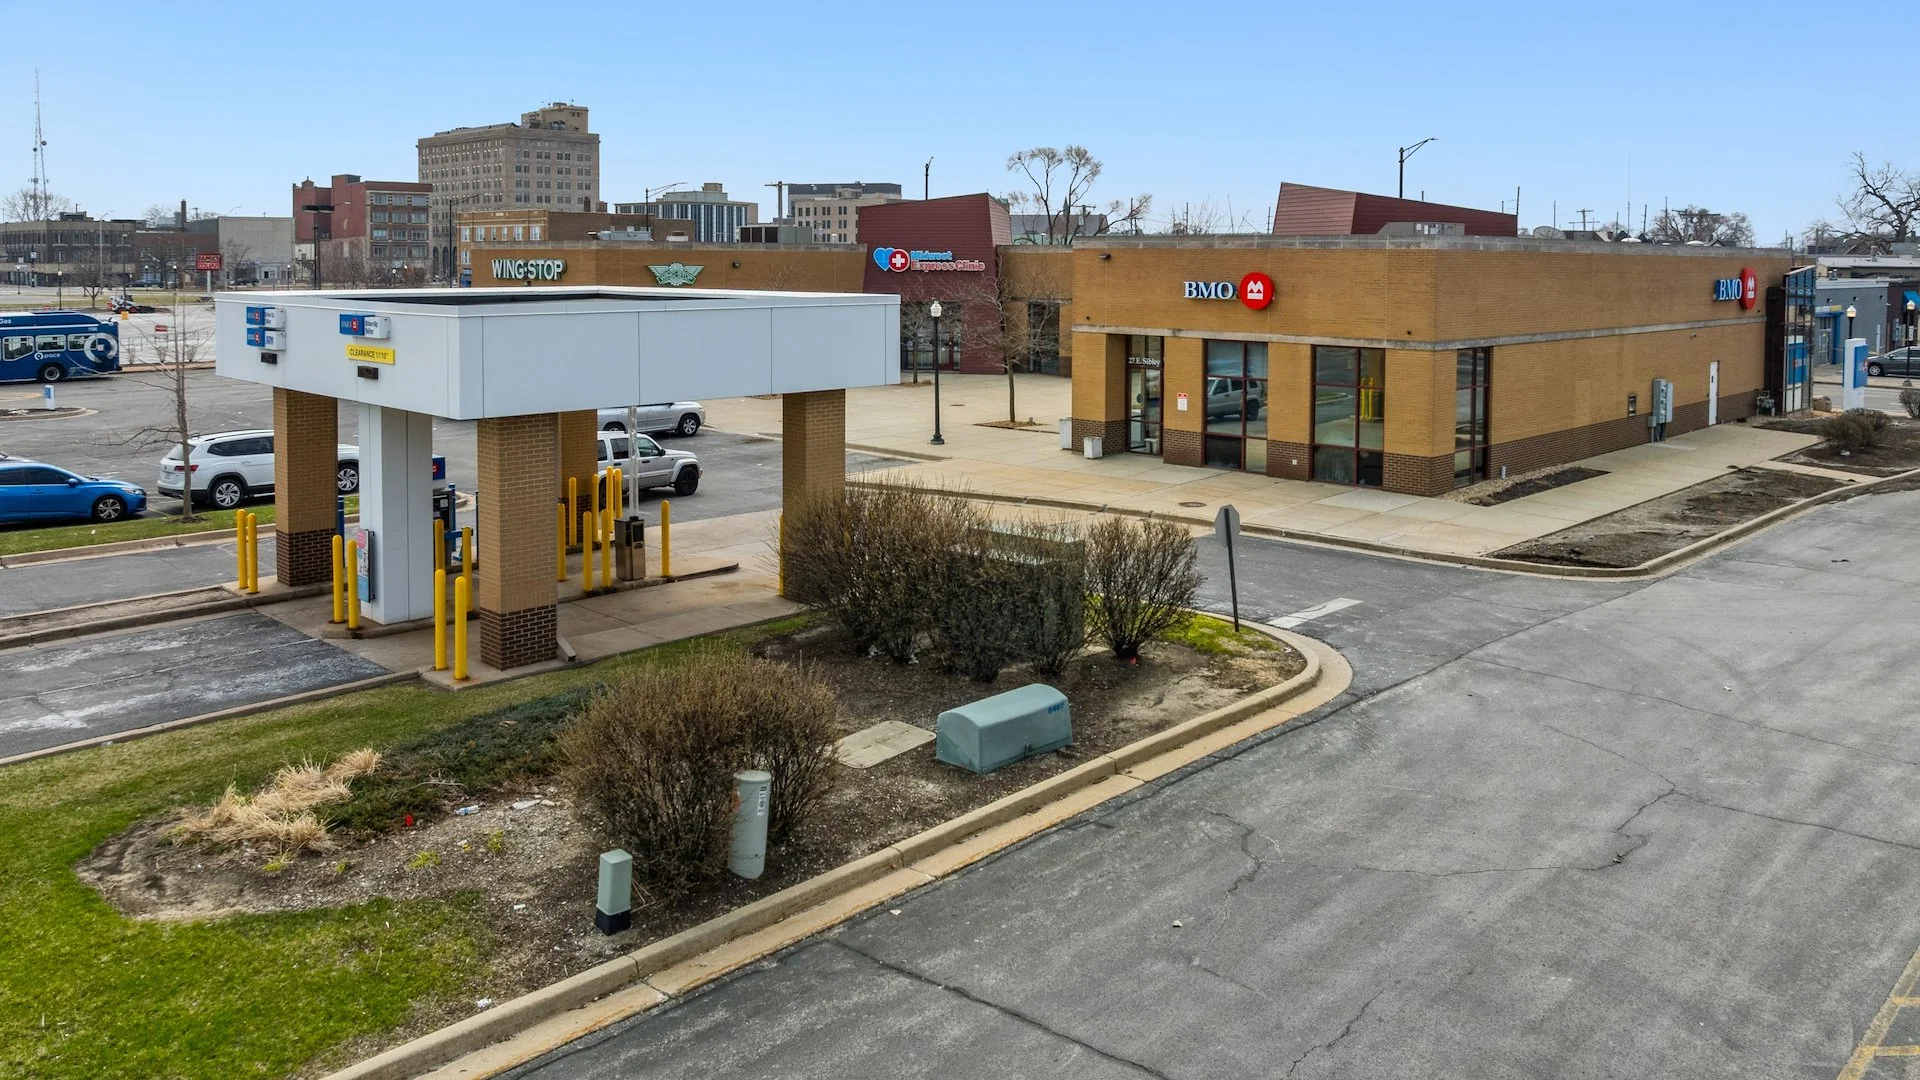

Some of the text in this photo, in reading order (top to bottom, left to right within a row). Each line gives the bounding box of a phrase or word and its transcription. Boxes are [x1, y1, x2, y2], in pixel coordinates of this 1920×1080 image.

[911, 250, 953, 260] Midwest
[911, 260, 985, 271] Express Clinic
[1183, 281, 1235, 300] BMO
[1719, 278, 1743, 301] BMO
[349, 348, 375, 359] CLEARANCE
[1128, 356, 1135, 364] 27
[1142, 357, 1161, 367] Sibley
